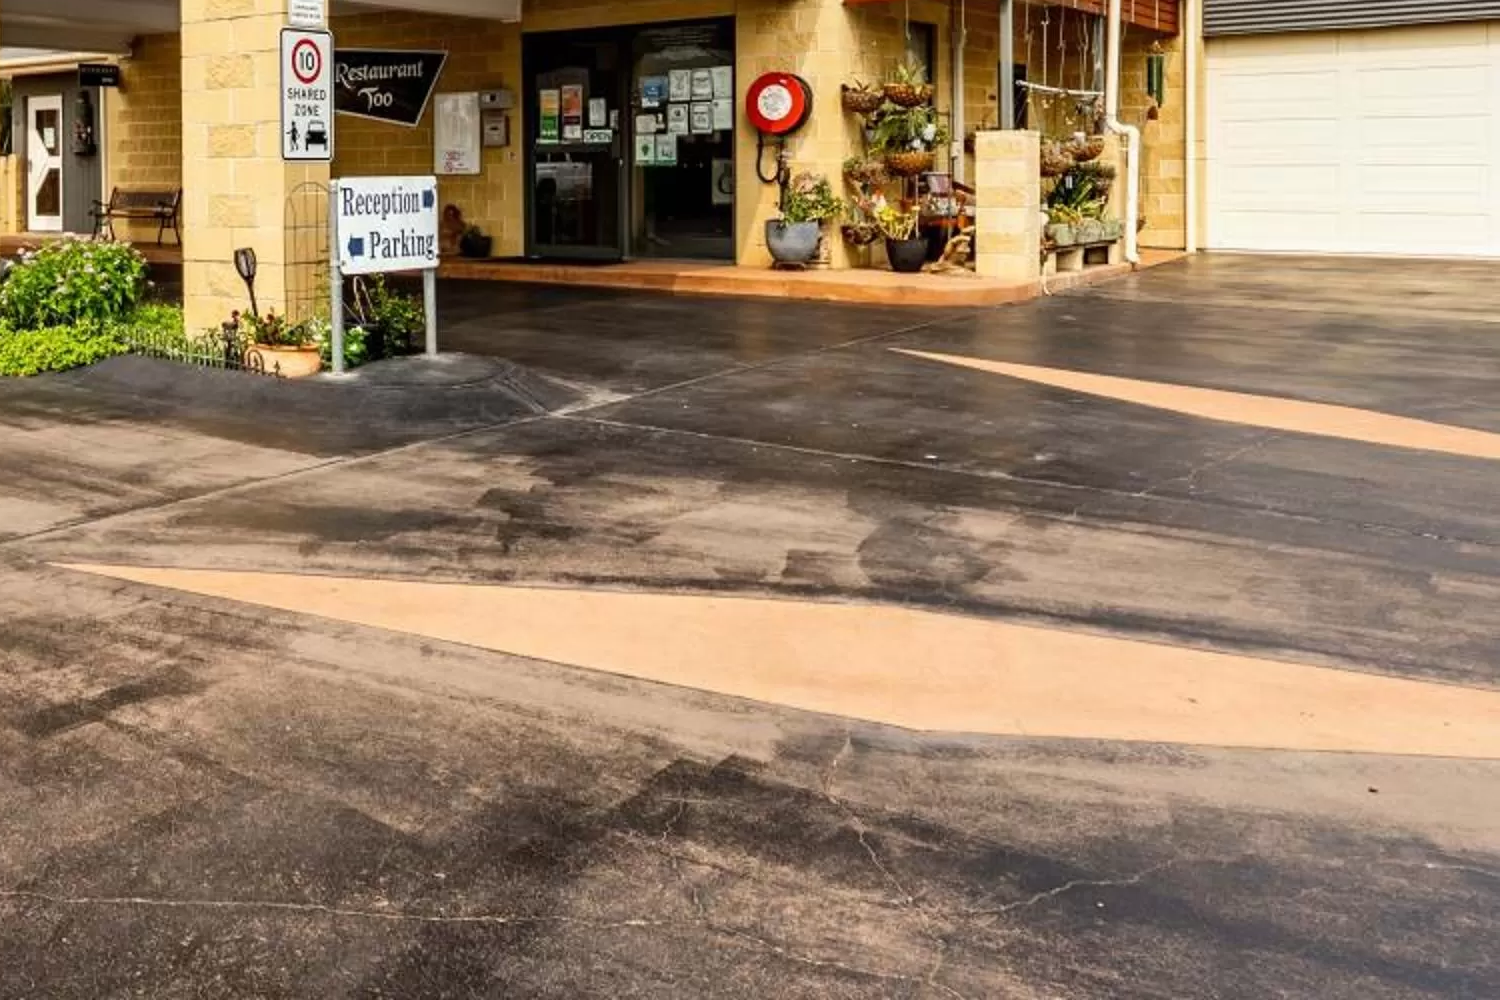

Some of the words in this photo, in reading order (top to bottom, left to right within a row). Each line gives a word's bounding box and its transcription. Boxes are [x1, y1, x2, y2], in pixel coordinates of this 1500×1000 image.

[299, 51, 315, 71] 10
[335, 60, 424, 90] Restaurant
[287, 87, 327, 101] SHARED
[357, 86, 393, 112] Too
[294, 103, 321, 117] ZONE
[340, 186, 420, 220] Reception
[369, 229, 435, 260] Parking
